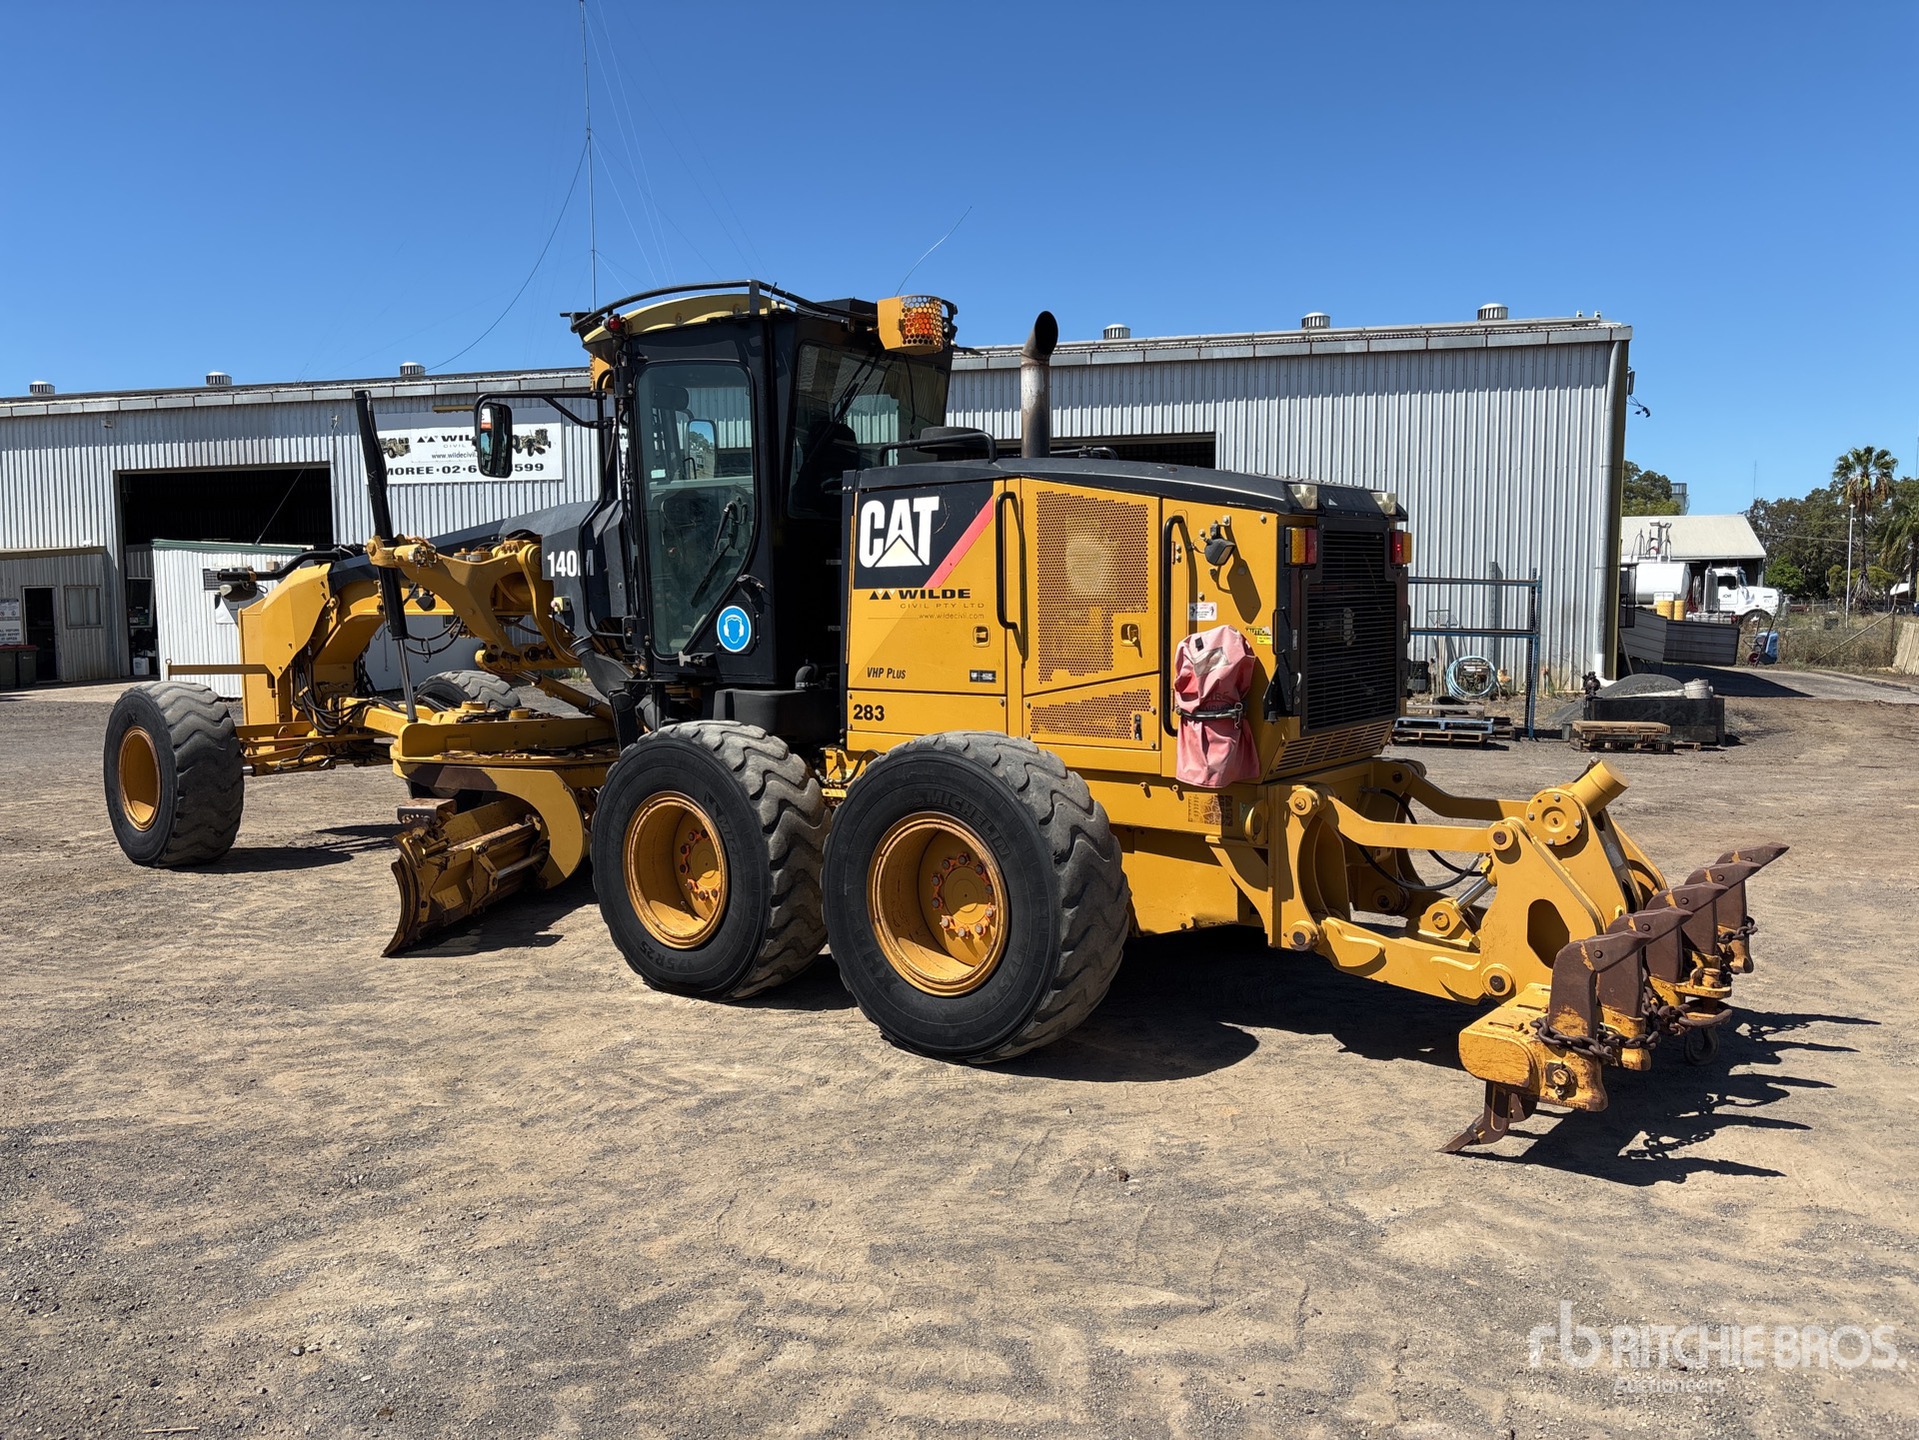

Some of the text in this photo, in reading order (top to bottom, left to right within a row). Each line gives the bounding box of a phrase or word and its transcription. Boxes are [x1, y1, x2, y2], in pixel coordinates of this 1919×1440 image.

[441, 434, 473, 442] WIL
[859, 496, 940, 568] CAT
[898, 588, 971, 599] WILDE
[867, 667, 906, 679] VHP PLUS
[853, 704, 885, 721] 283
[926, 790, 1011, 858] MICHELIN
